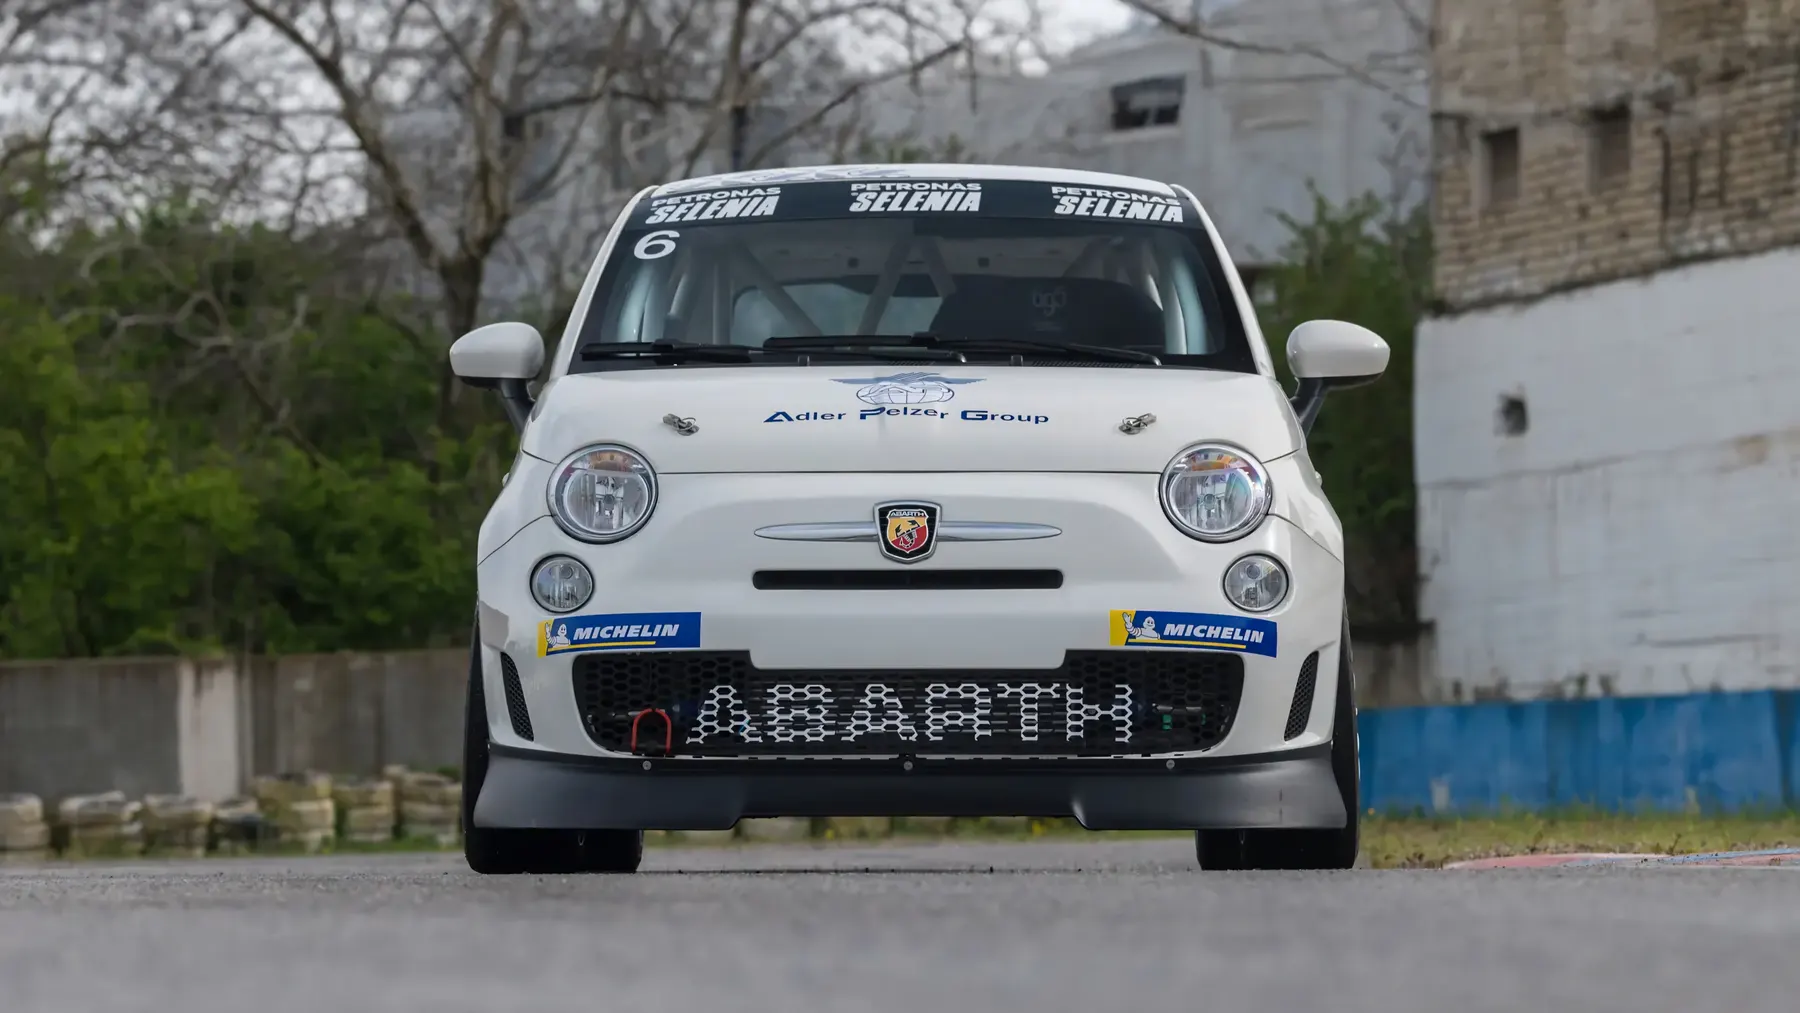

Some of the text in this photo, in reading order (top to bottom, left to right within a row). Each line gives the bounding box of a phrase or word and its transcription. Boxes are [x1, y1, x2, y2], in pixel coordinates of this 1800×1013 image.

[651, 187, 782, 208] PETRONAS
[850, 183, 982, 191] PETRONAS
[1051, 186, 1181, 206] PETRONAS
[645, 195, 780, 225] SELENIA
[849, 191, 982, 213] SELENIA
[1053, 195, 1184, 223] SELENIA
[633, 230, 681, 260] 6
[763, 406, 1049, 425] Adler Pelzer Group
[573, 624, 680, 641] MICHELIN
[1163, 623, 1265, 644] MICHELIN
[686, 683, 1133, 744] ABARTH
